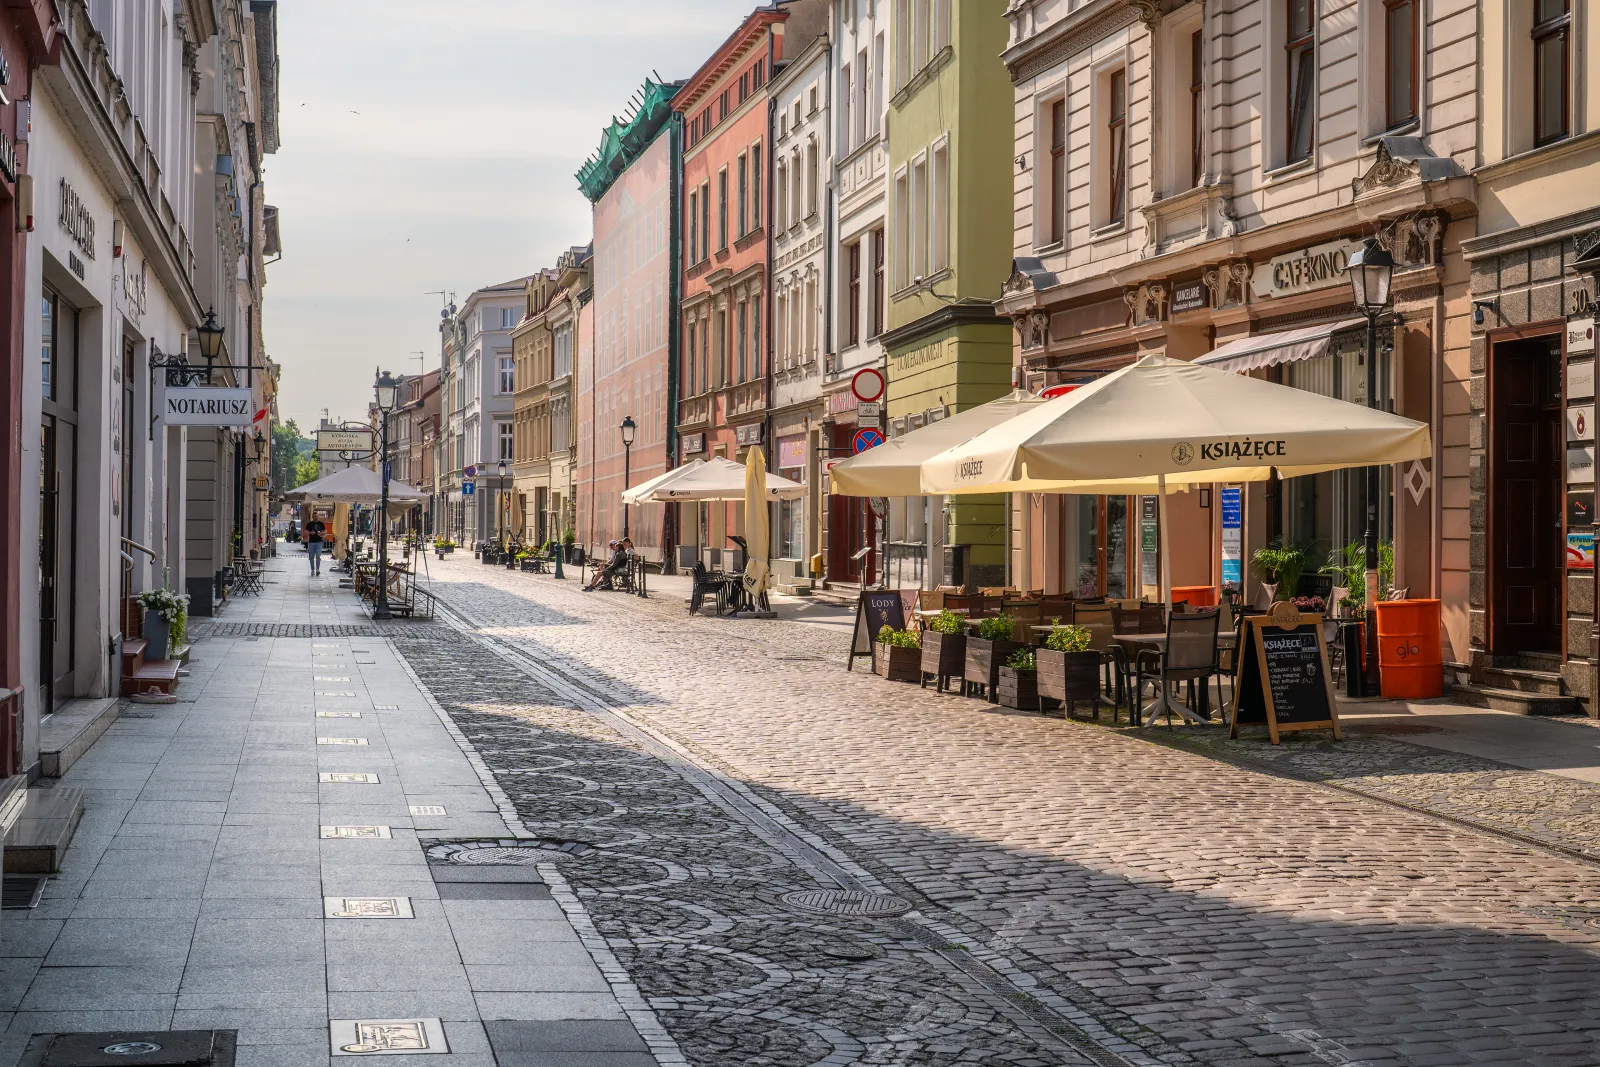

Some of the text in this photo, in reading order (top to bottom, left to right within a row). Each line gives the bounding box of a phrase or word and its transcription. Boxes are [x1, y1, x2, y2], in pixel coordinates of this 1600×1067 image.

[1571, 287, 1588, 313] 30
[167, 398, 248, 415] NOTARIUSZ
[1201, 436, 1287, 461] KSIĄŻĘCE
[871, 599, 895, 608] LODY
[1264, 638, 1301, 651] KSIĄŻĘCE
[1396, 639, 1420, 660] glo
